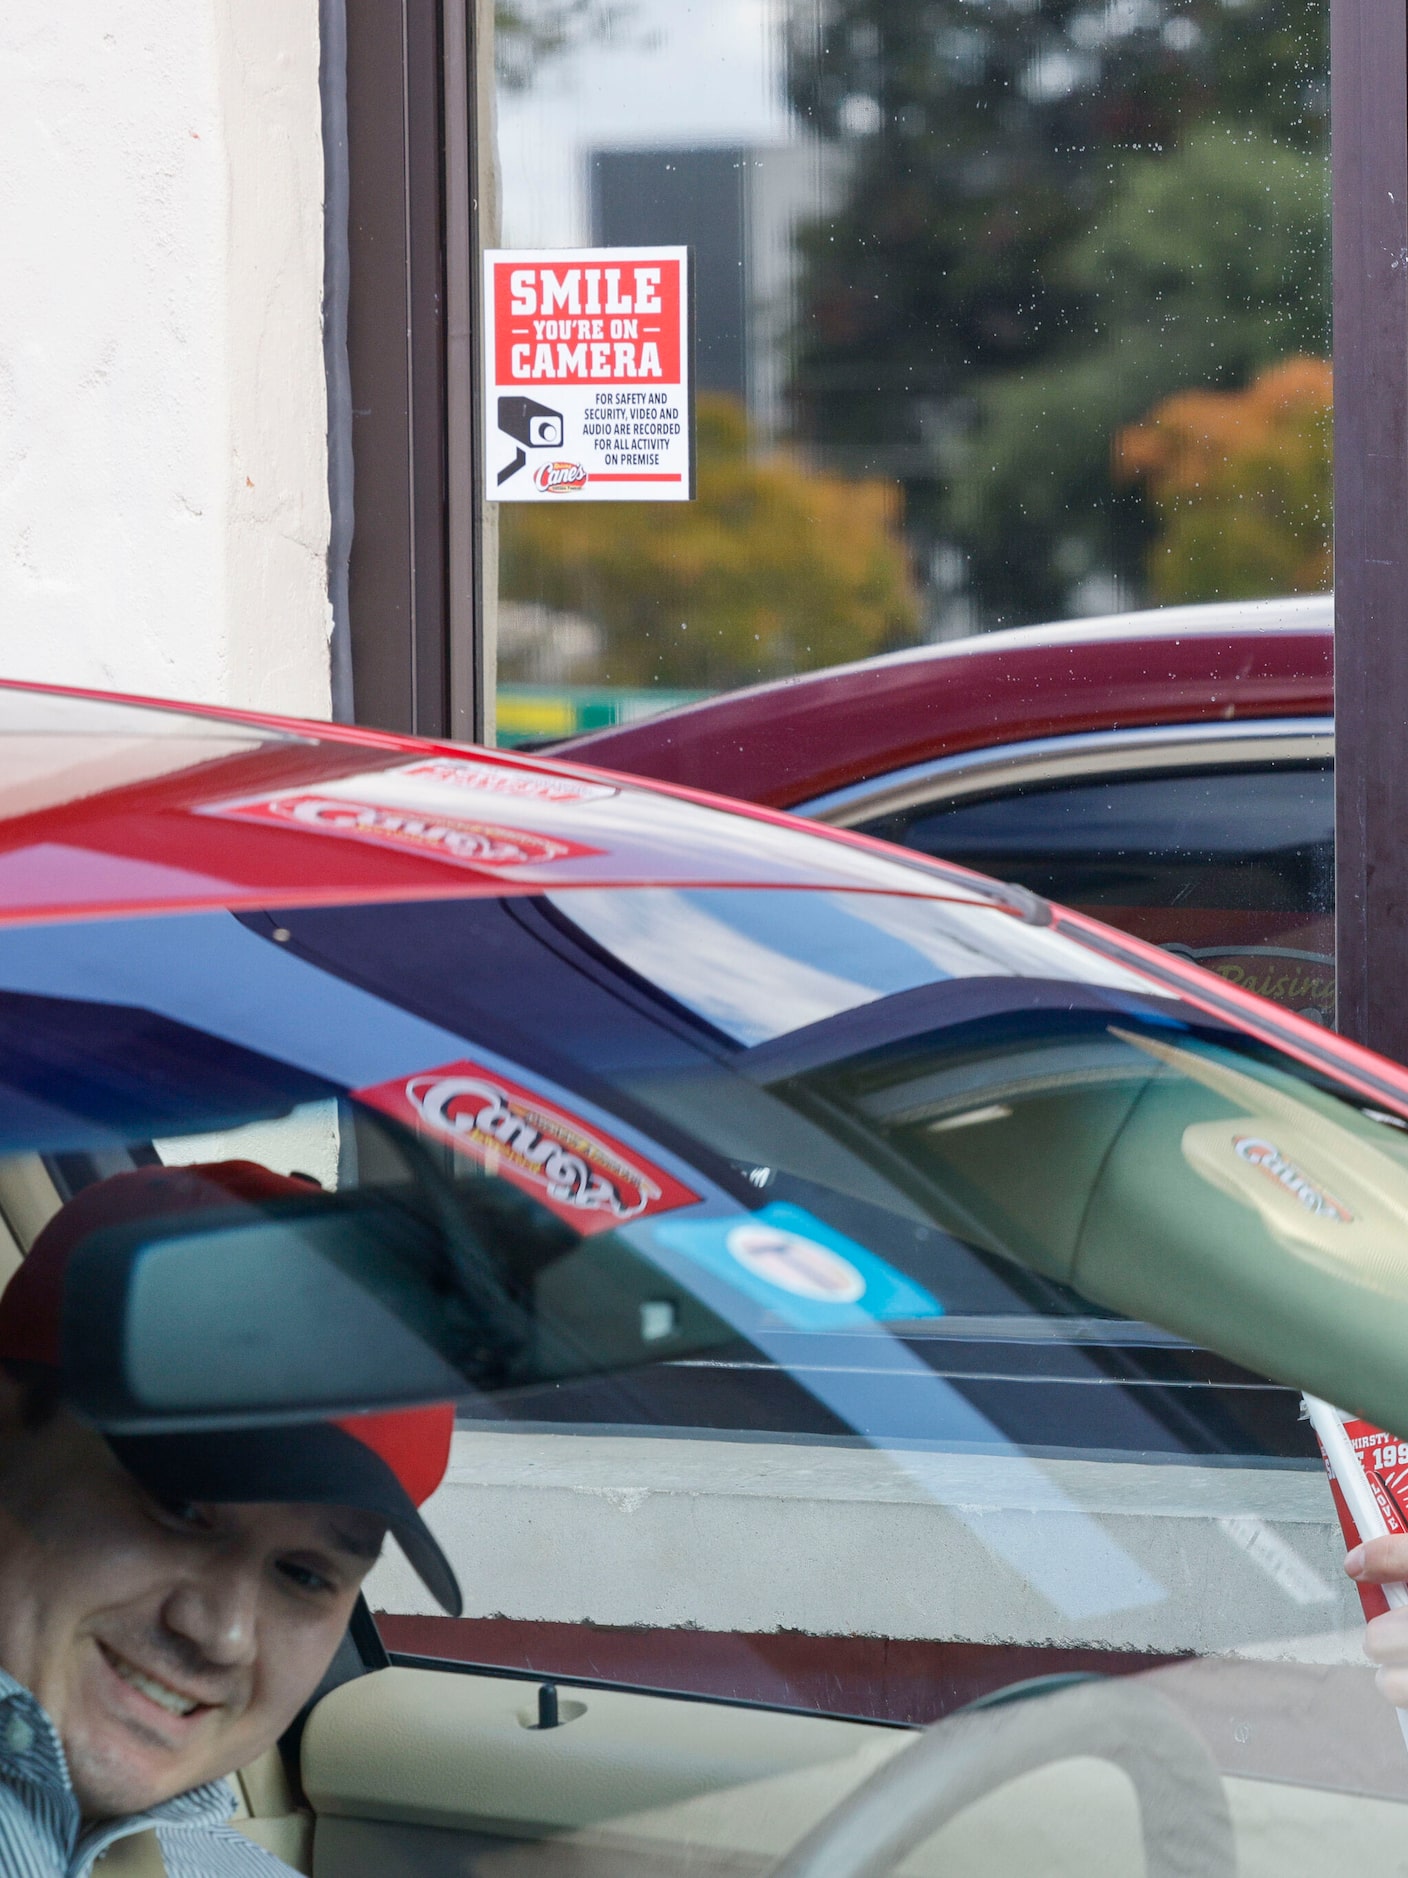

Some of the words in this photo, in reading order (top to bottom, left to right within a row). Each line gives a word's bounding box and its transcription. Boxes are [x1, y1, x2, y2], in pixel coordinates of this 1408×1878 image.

[510, 267, 662, 316] SMILE
[532, 318, 604, 341] YOU'RE
[610, 318, 639, 340] ON
[511, 342, 663, 379] CAMERA
[595, 393, 613, 405] FOR
[615, 393, 647, 405] SAFETY
[648, 392, 668, 405] AND
[584, 408, 628, 421] SECURITY,
[630, 407, 658, 420] VIDEO
[659, 407, 679, 420] AND
[582, 424, 612, 435] AUDIO
[613, 423, 631, 435] ARE
[633, 423, 681, 435] RECORDED
[594, 439, 612, 451] FOR
[613, 438, 630, 450] ALL
[631, 438, 670, 450] ACTIVITY
[604, 454, 619, 466] ON
[620, 453, 659, 466] PREMISE
[1351, 1432, 1390, 1450] HIRSTY
[1370, 1483, 1399, 1531] LOVE
